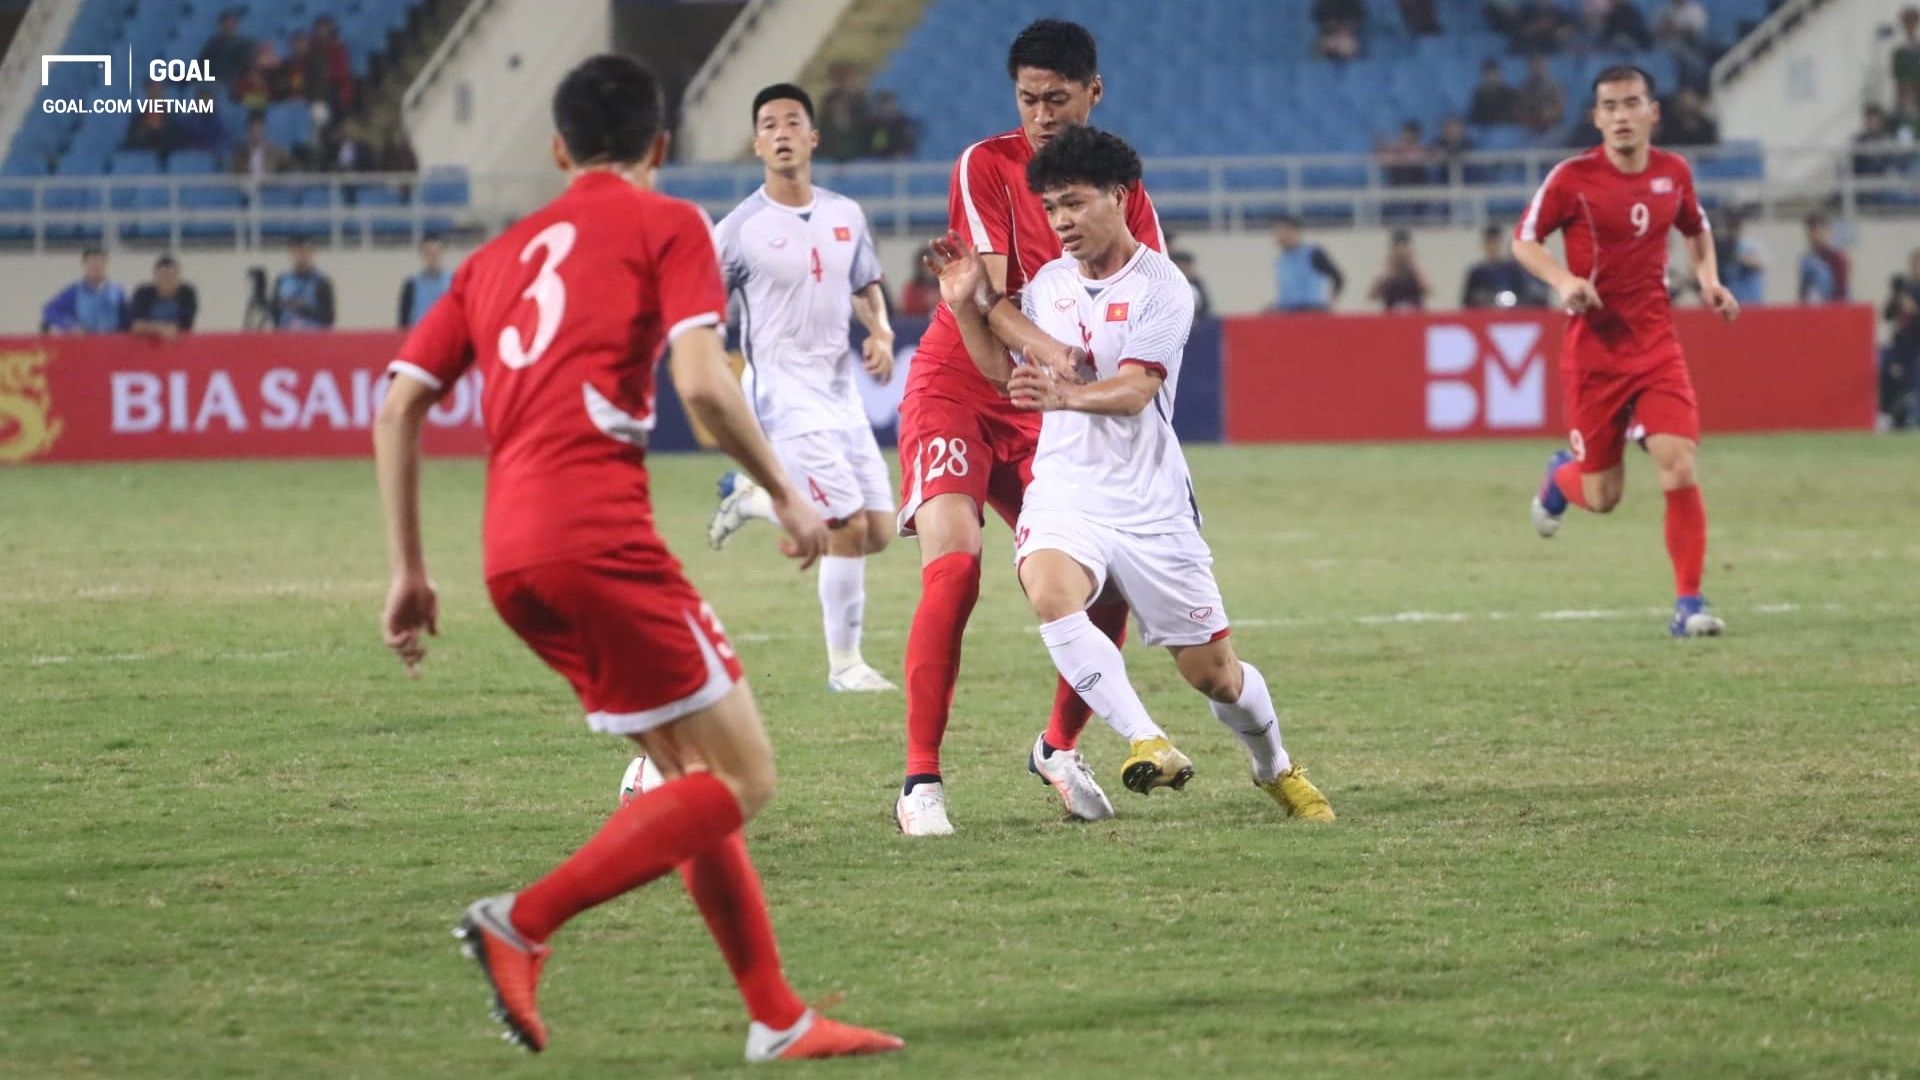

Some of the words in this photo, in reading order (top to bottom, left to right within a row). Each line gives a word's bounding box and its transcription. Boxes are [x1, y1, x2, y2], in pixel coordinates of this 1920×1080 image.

[1630, 202, 1649, 237] 9
[811, 247, 823, 282] 4
[498, 221, 577, 370] 3
[110, 370, 248, 433] BIA
[925, 437, 968, 482] 28
[807, 476, 830, 507] 4
